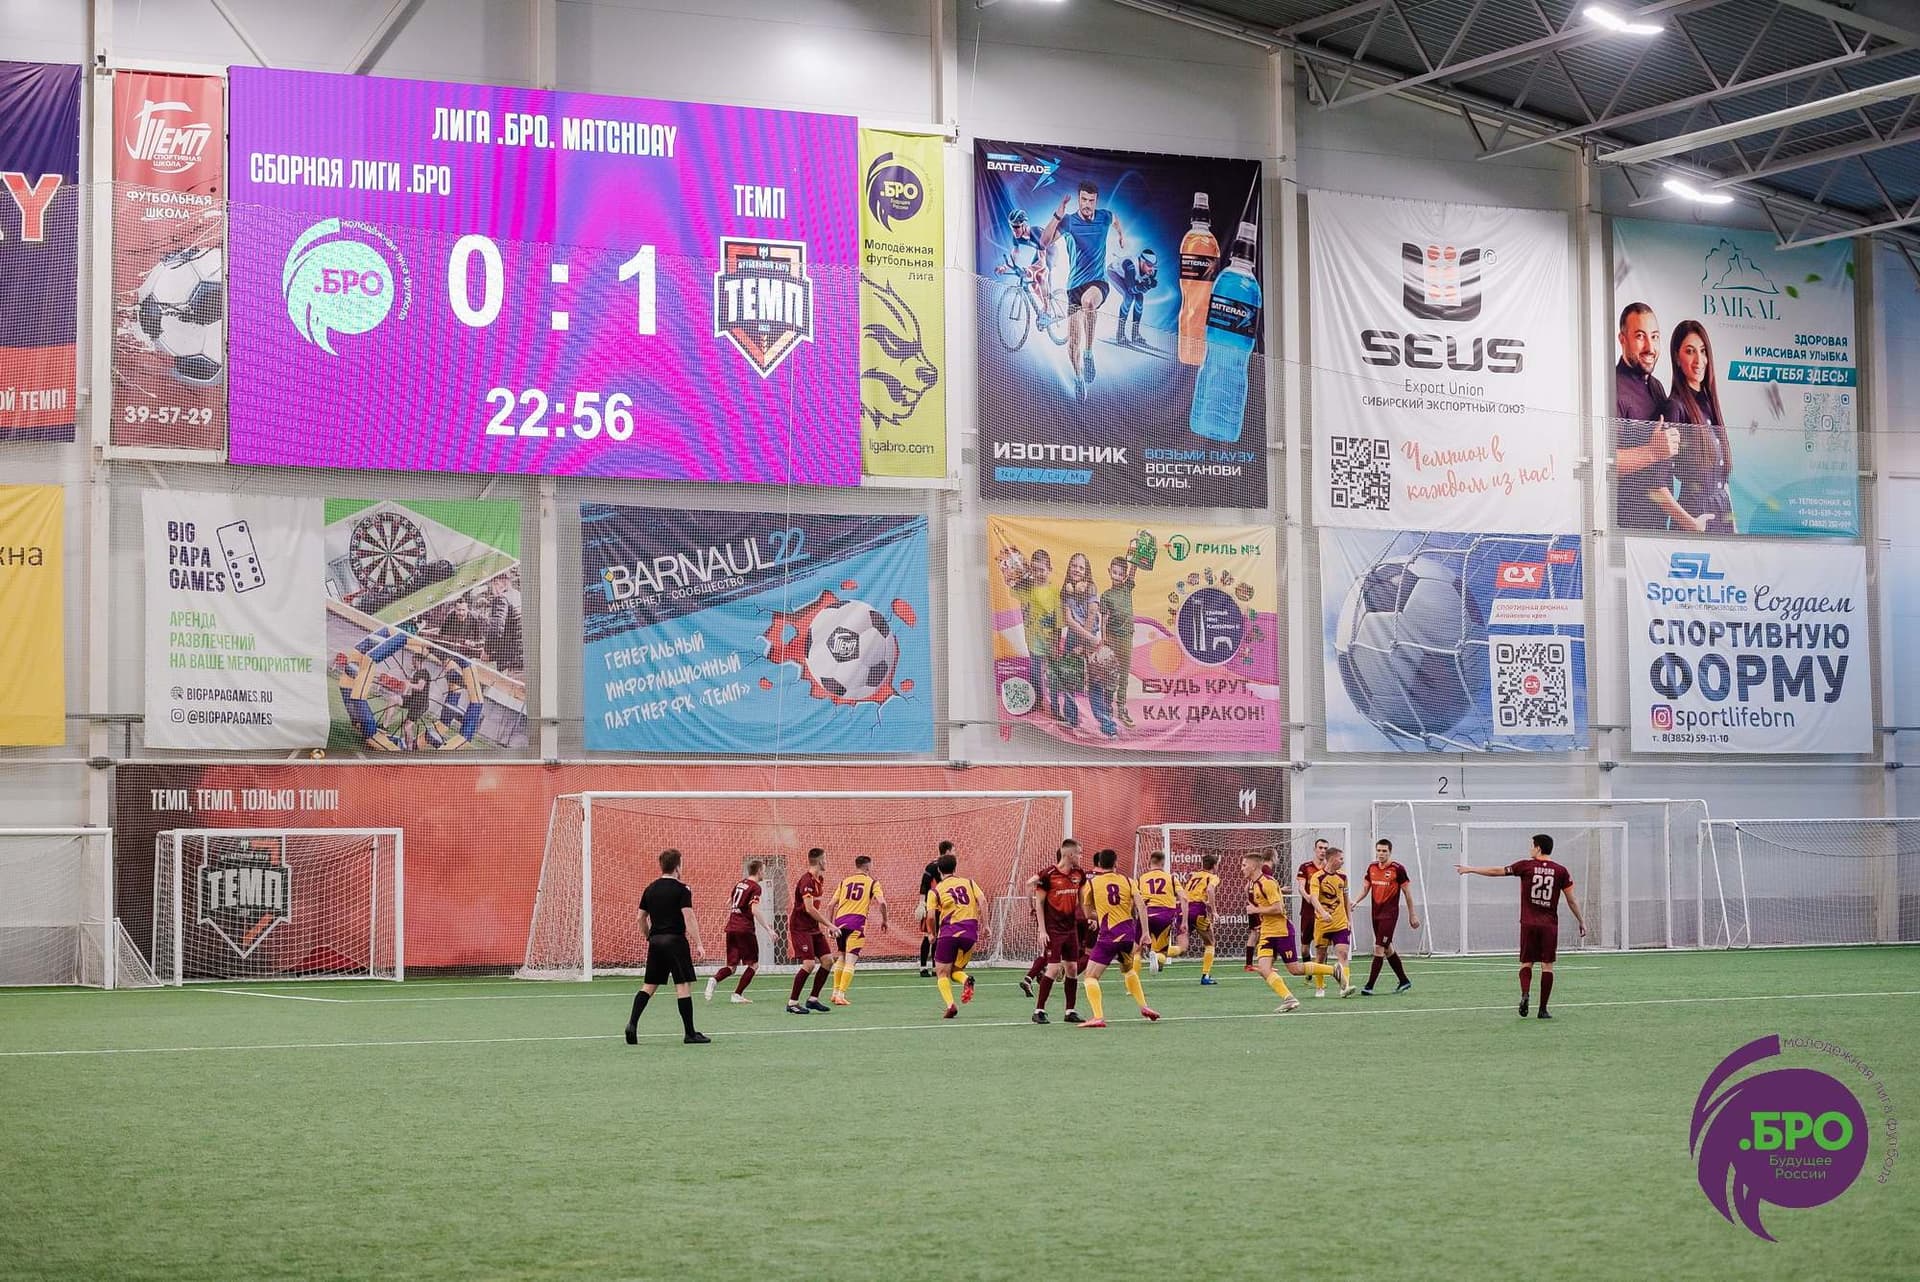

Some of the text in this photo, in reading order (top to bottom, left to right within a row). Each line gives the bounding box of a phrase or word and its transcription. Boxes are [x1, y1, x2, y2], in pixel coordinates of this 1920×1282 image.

[126, 99, 212, 160] ТЕМП
[431, 107, 678, 158] ЛИГА .БРО. MATCHDAY
[249, 152, 451, 195] СБОРНАЯ ЛИГИ .БРО
[987, 161, 1051, 174] BATTERADE
[126, 191, 212, 206] ФУТБОЛЬНАЯ
[734, 184, 786, 219] ТЕМП
[880, 181, 919, 200] .БРО
[146, 208, 190, 218] ШКОЛА
[864, 239, 934, 255] Молодёжная
[866, 253, 934, 267] футбольная
[313, 268, 384, 297] .БРО
[448, 234, 504, 328] 0
[618, 244, 657, 335] 1
[908, 272, 934, 281] лига
[725, 278, 803, 328] ТЕМП
[1703, 294, 1781, 320] BAIKAL
[1360, 330, 1525, 373] SEUS
[1794, 334, 1848, 347] ЗДОРОВАЯ
[1745, 346, 1848, 362] И КРАСИВАЯ УЛЫБКА
[1738, 365, 1848, 383] ЖДЕТ ТЕБЯ ЗДЕСЬ!
[1405, 379, 1484, 396] Export Union
[20, 388, 66, 410] ТЕМП!
[1362, 395, 1526, 414] СИБИРСКИЙ ЭКСПОРТНЫЙ СОЮЗ
[124, 406, 212, 425] 39-57-29
[486, 387, 634, 442] 22:56
[994, 442, 1128, 464] ИЗОТОНИК
[1145, 449, 1205, 461] ВОЗЬМИ
[1401, 434, 1504, 472] Чемпион в
[1145, 463, 1242, 477] ВОССТАНОВИ
[1406, 455, 1555, 501] каждом из нас!
[1146, 477, 1191, 489] СИЛЫ.
[167, 520, 196, 543] BIG
[0, 546, 43, 566] на
[168, 545, 211, 568] PAPA
[1195, 543, 1237, 555] ГРИЛЬ
[1668, 552, 1725, 580] SL
[169, 568, 226, 593] GAMES
[607, 593, 662, 612] ИНТЕРНЕТ
[671, 575, 745, 600] СООБЩЕСТВО
[1647, 582, 1747, 605] SportLife
[1753, 584, 1855, 620] Создаем
[169, 611, 216, 628] АРЕНДА
[169, 631, 256, 650] РАЗВЛЕЧЕНИЙ
[1648, 618, 1850, 648] СПОРТИВНУЮ
[604, 631, 705, 670] ГЕНЕРАЛЬНЫЙ
[169, 653, 313, 673] НА ВАШЕ МЕРОПРИЯТИЕ
[604, 653, 741, 702] ИНФОРМАЦИОННЫЙ
[1142, 678, 1253, 697] БУДЬ КРУТ,
[1649, 652, 1849, 703] ФОРМУ
[186, 687, 273, 703] BIGPAPAGAMES.RU
[604, 682, 751, 730] ПАРТНЕР ФК «ТЕМП»
[187, 709, 273, 725] @BIGPAPAGAMES
[1142, 705, 1265, 723] КАК ДРАКОН!
[1675, 706, 1795, 731] sportlifebrn
[1662, 732, 1695, 744] 8(3852)
[1695, 733, 1729, 743] 59-11-10
[1438, 776, 1448, 794] 2
[151, 789, 339, 812] ТЕМП, ТЕМП, ТОЛЬКО ТЕМП!
[208, 868, 282, 909] ТЕМП
[845, 882, 865, 901] 15
[1106, 883, 1121, 906] 8
[1146, 877, 1167, 895] 12
[1531, 875, 1554, 901] 23
